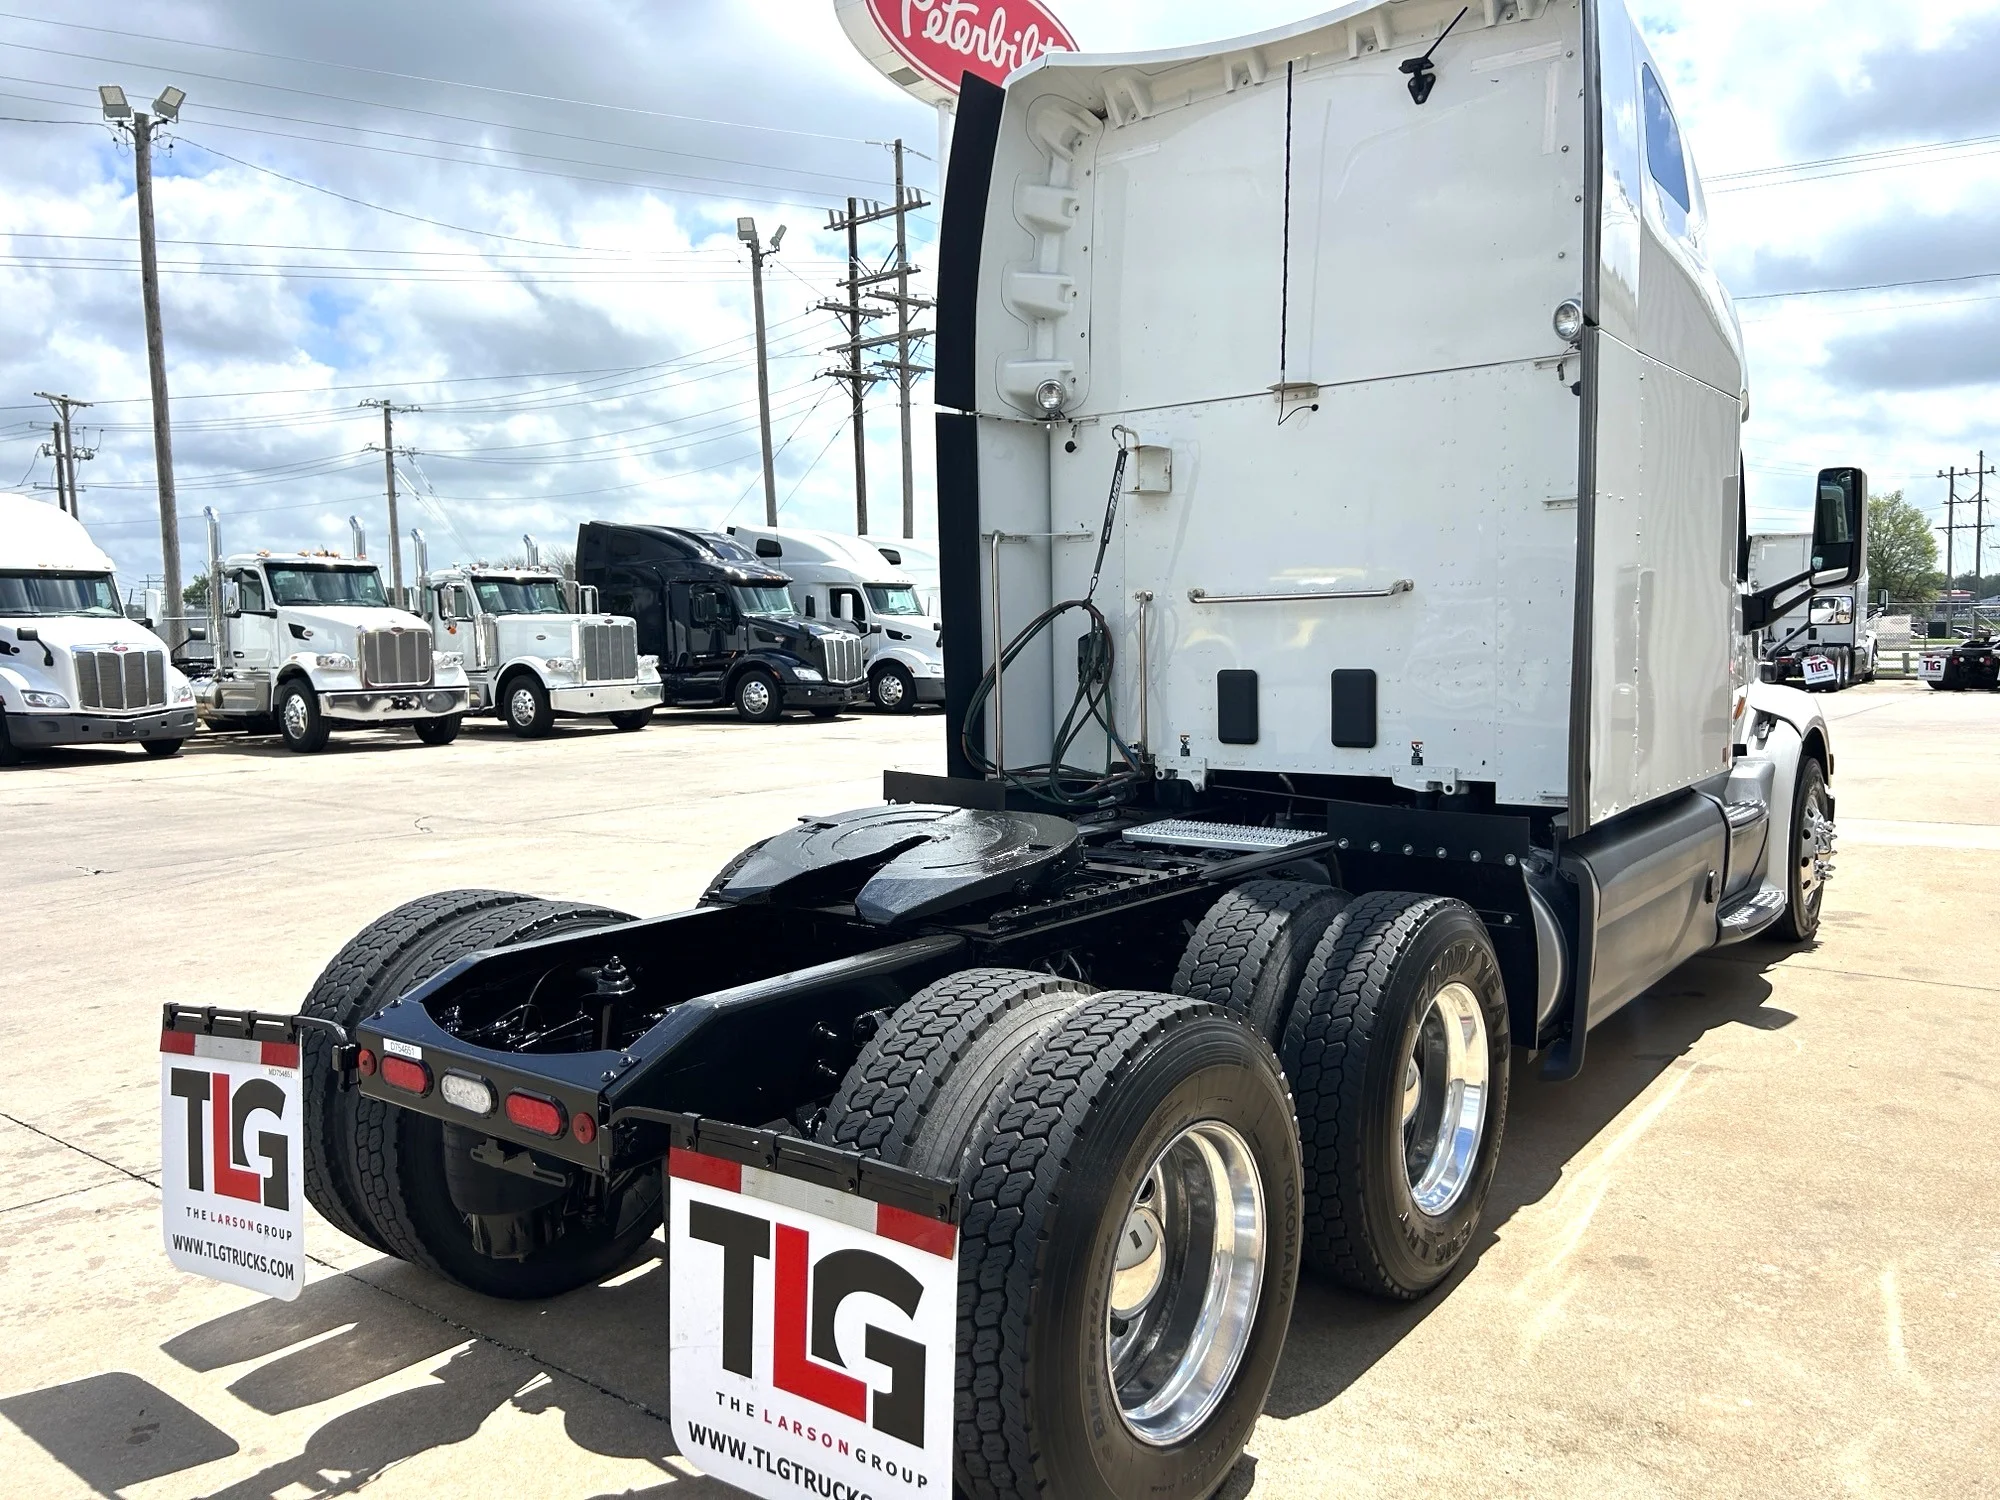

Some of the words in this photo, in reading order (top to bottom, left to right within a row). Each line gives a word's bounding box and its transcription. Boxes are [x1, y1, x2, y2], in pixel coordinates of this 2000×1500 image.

[1807, 661, 1828, 673] TLG
[1923, 660, 1941, 671] TLG
[171, 1067, 290, 1211] TLG
[172, 1233, 294, 1281] WWW.TLGTRUCKS.COM
[186, 1206, 206, 1220] THE
[210, 1212, 254, 1231] LARSON
[256, 1223, 292, 1241] GROUP
[1278, 1168, 1296, 1307] YOKOHAMA
[689, 1199, 926, 1450] TLG
[716, 1391, 755, 1417] THE
[764, 1409, 849, 1456] LARSON
[855, 1448, 928, 1488] GROUP
